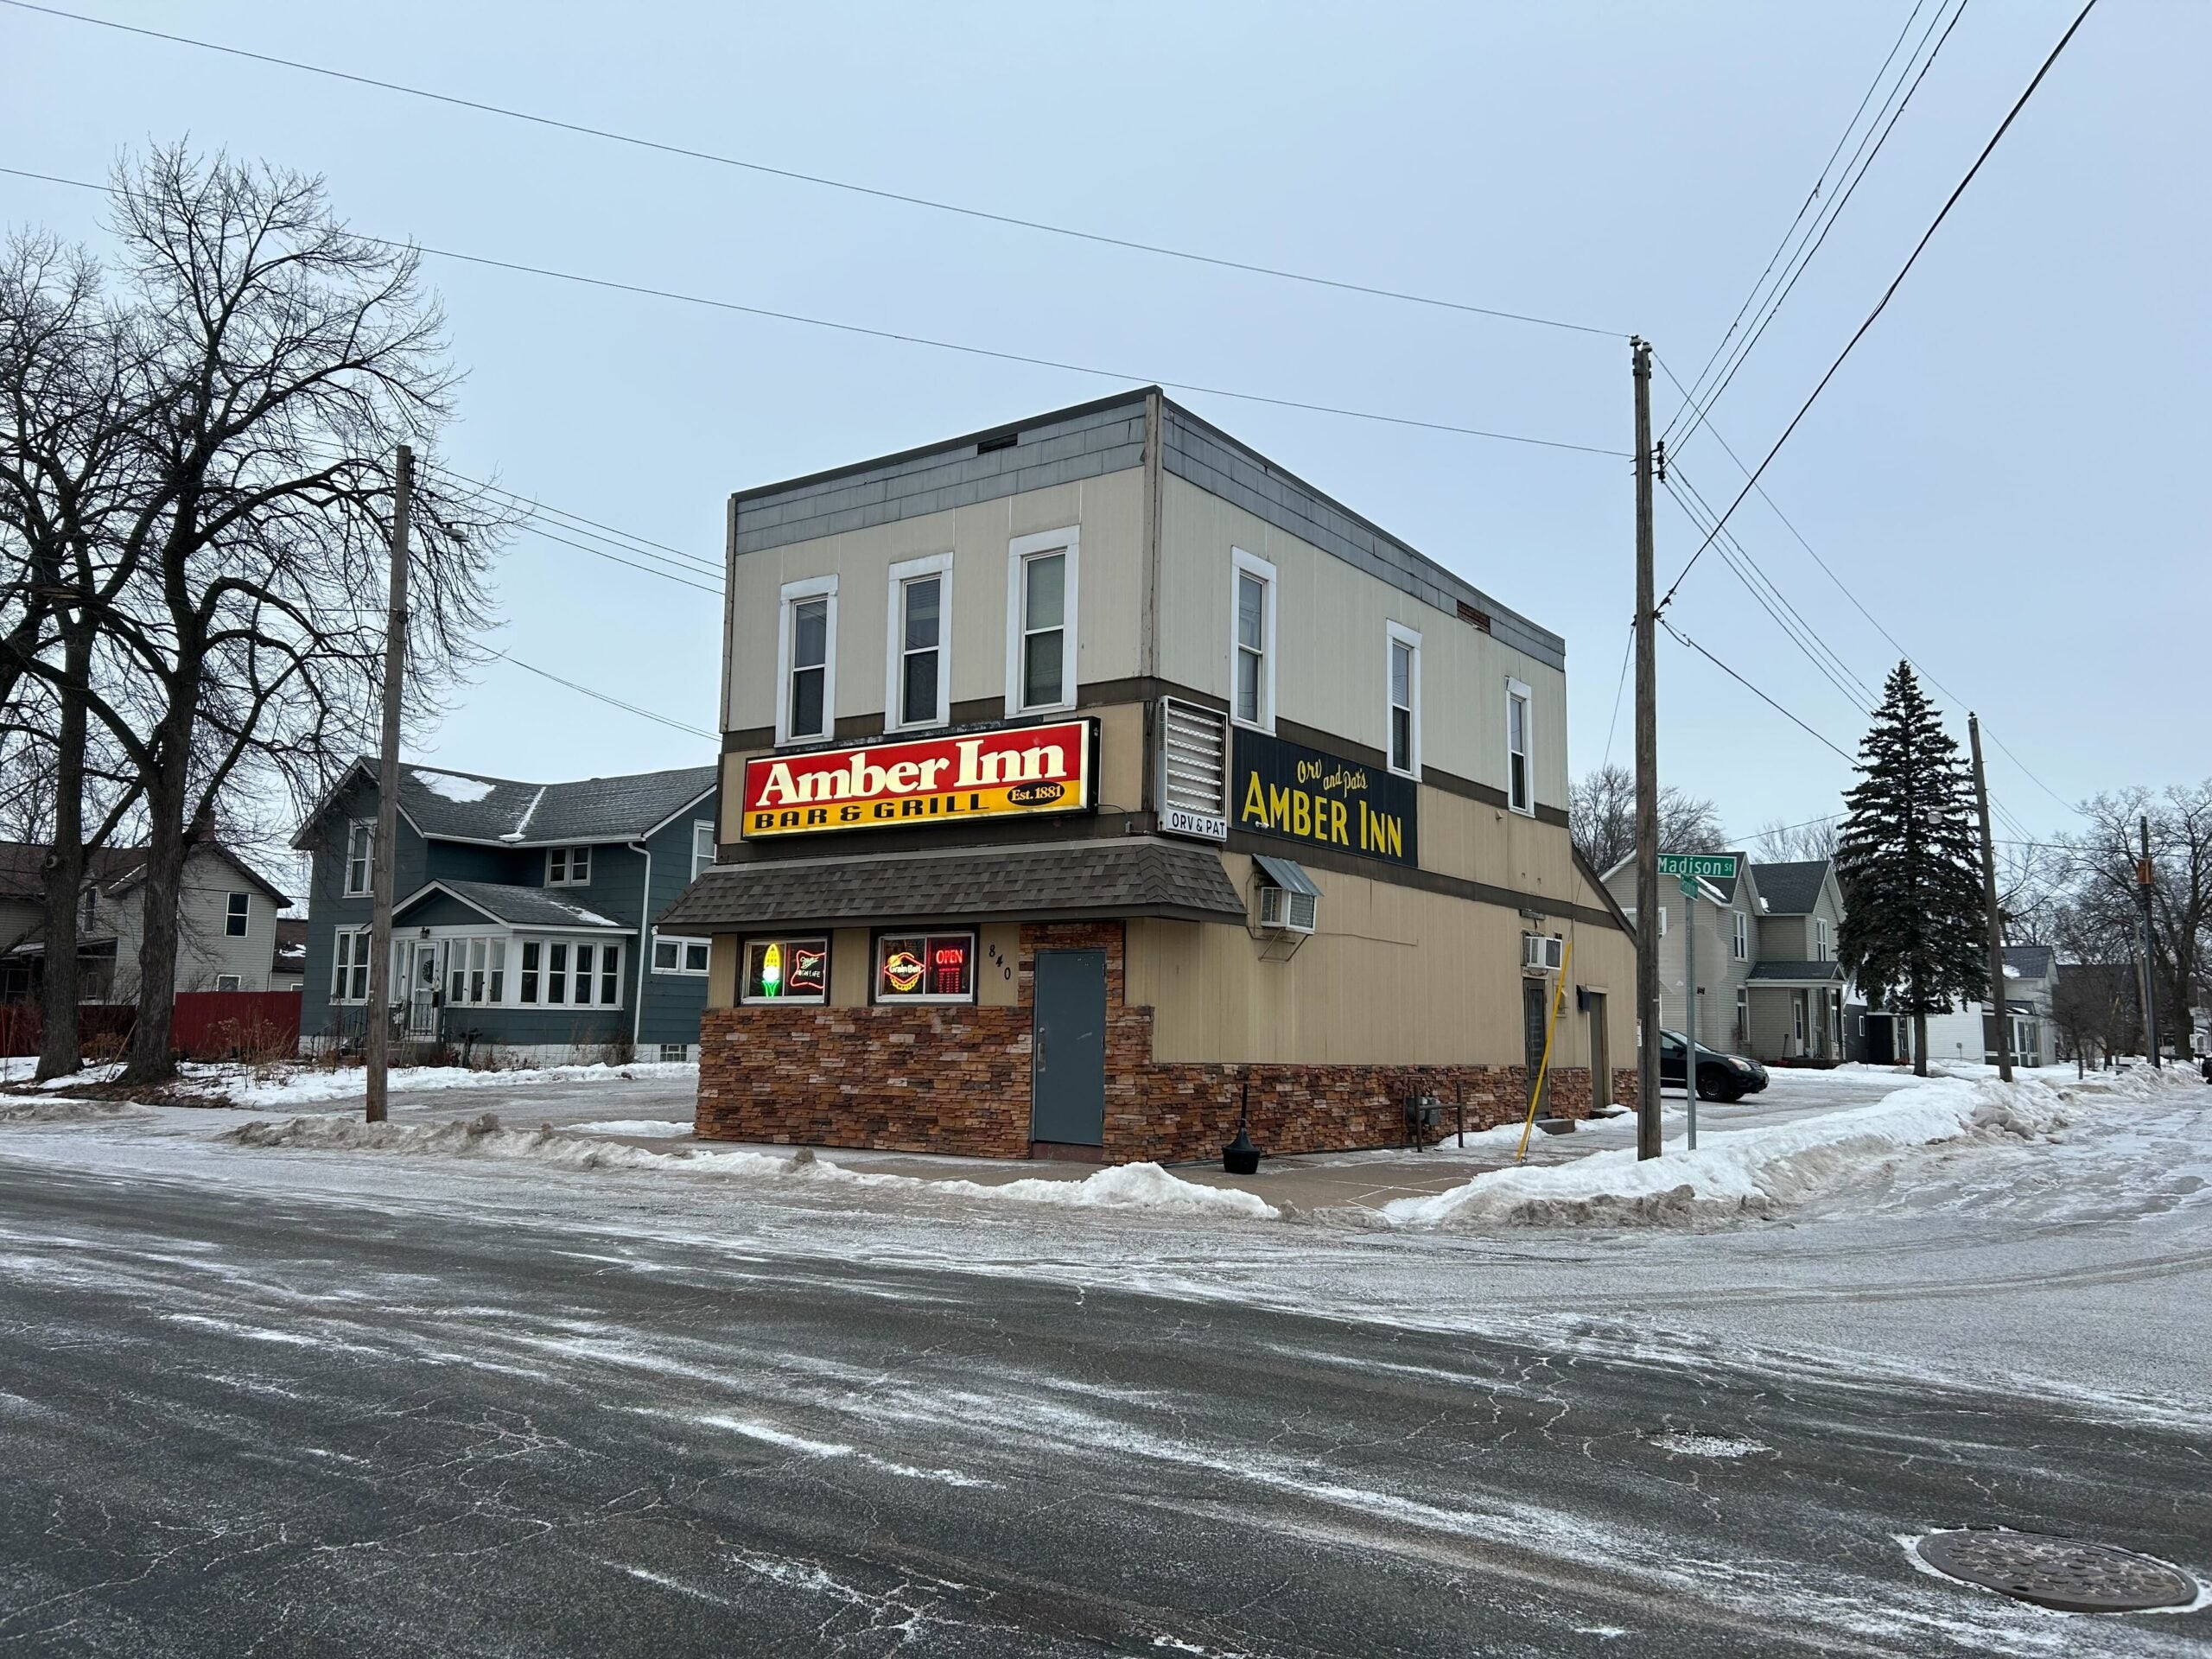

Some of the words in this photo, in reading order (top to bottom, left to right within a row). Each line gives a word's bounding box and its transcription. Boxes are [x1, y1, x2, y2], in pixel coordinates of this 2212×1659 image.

[756, 753, 950, 806] Amber
[953, 740, 1066, 787] Inn
[1297, 759, 1322, 784] Orv
[1323, 764, 1343, 791] and
[1011, 788, 1033, 802] Est.
[1035, 784, 1062, 798] 1881
[755, 808, 827, 829] BAR
[840, 805, 862, 822] &
[874, 793, 989, 818] GRILL
[1242, 771, 1349, 846] AMBER
[1359, 800, 1402, 857] INN
[1172, 812, 1193, 830] ORV
[1196, 818, 1203, 832] &
[1206, 820, 1225, 836] PAT
[1658, 857, 1721, 875] Madison
[1724, 863, 1732, 872] St
[888, 964, 907, 973] Grain
[936, 949, 963, 964] OPEN
